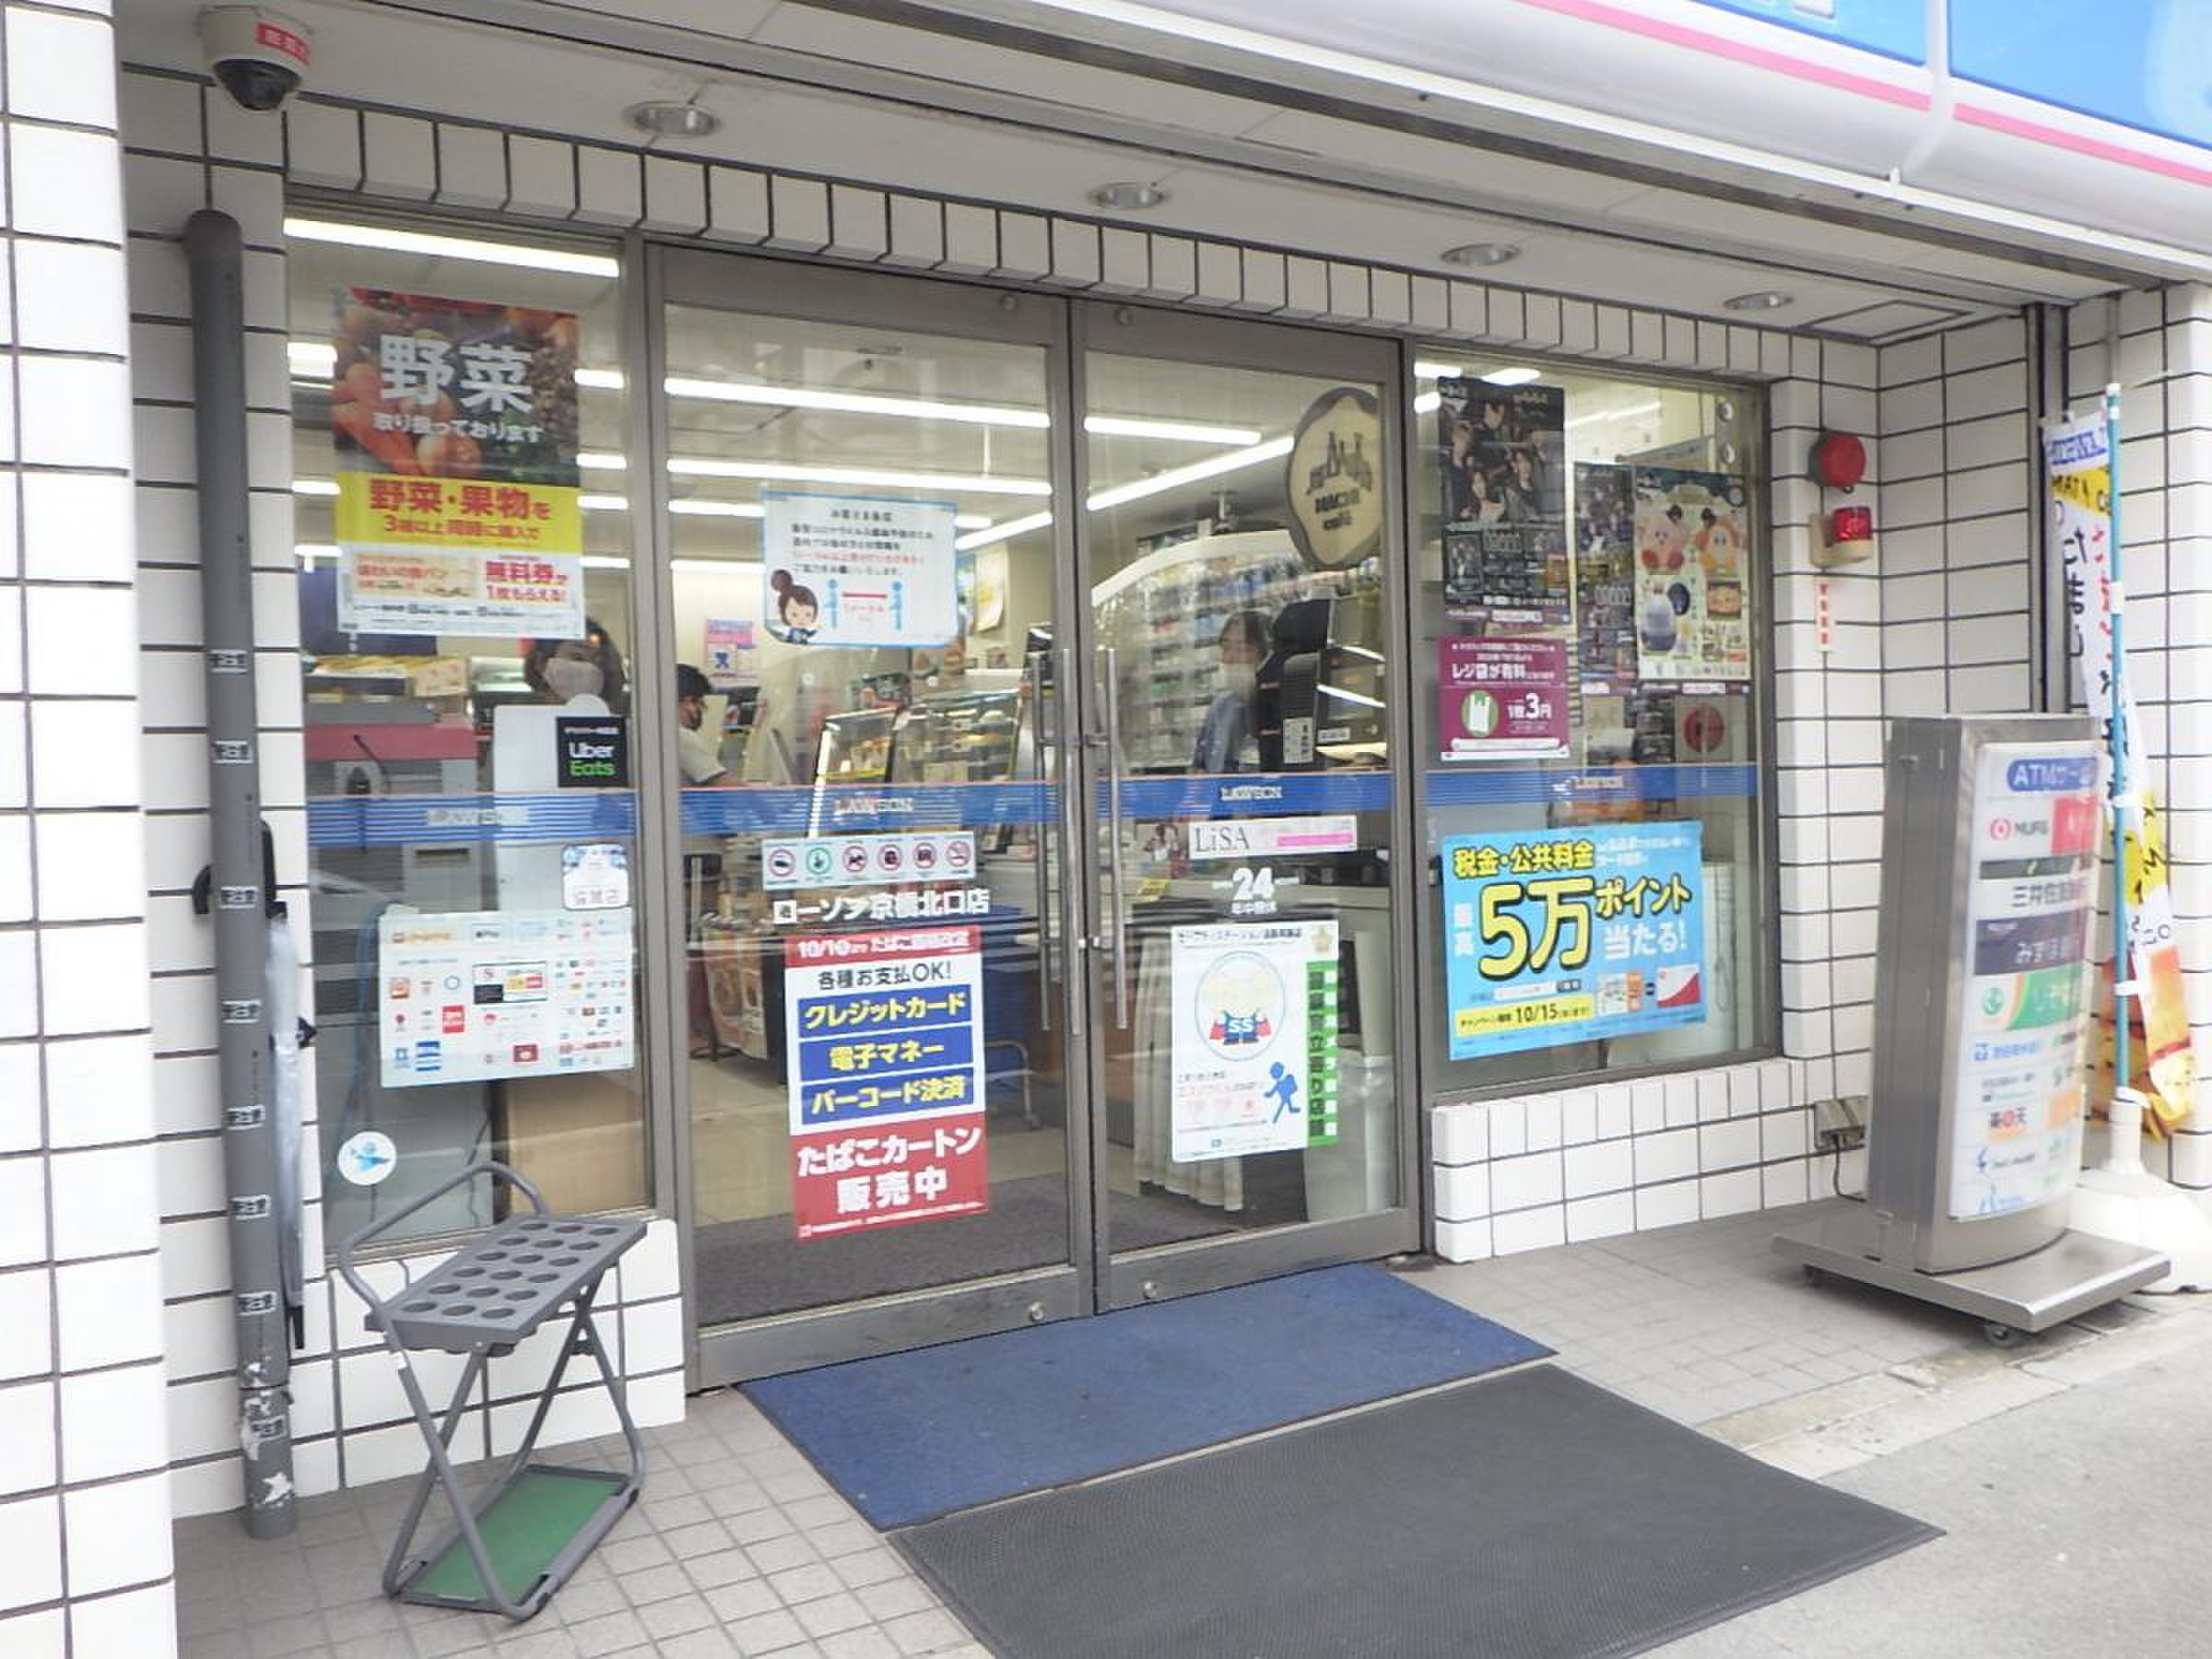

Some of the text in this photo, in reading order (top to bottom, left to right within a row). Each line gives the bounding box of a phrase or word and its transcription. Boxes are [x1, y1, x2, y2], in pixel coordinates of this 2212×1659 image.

[380, 335, 533, 414] 野菜
[369, 477, 552, 522] 野菜・果物を
[569, 741, 615, 759] Uber
[569, 759, 618, 776] Eats
[1194, 826, 1251, 853] LiSA
[1453, 839, 1594, 879] 税金・公共料金
[1232, 866, 1275, 901] 24
[1594, 872, 1693, 920] ポイント
[817, 960, 952, 991] 各種お支払OK!
[805, 991, 967, 1030] クレジットカード
[829, 1041, 946, 1073] 電子マネー
[811, 1075, 966, 1116] バーコード決済
[796, 1125, 982, 1178] たばこカートン
[835, 1165, 949, 1215] 販売中
